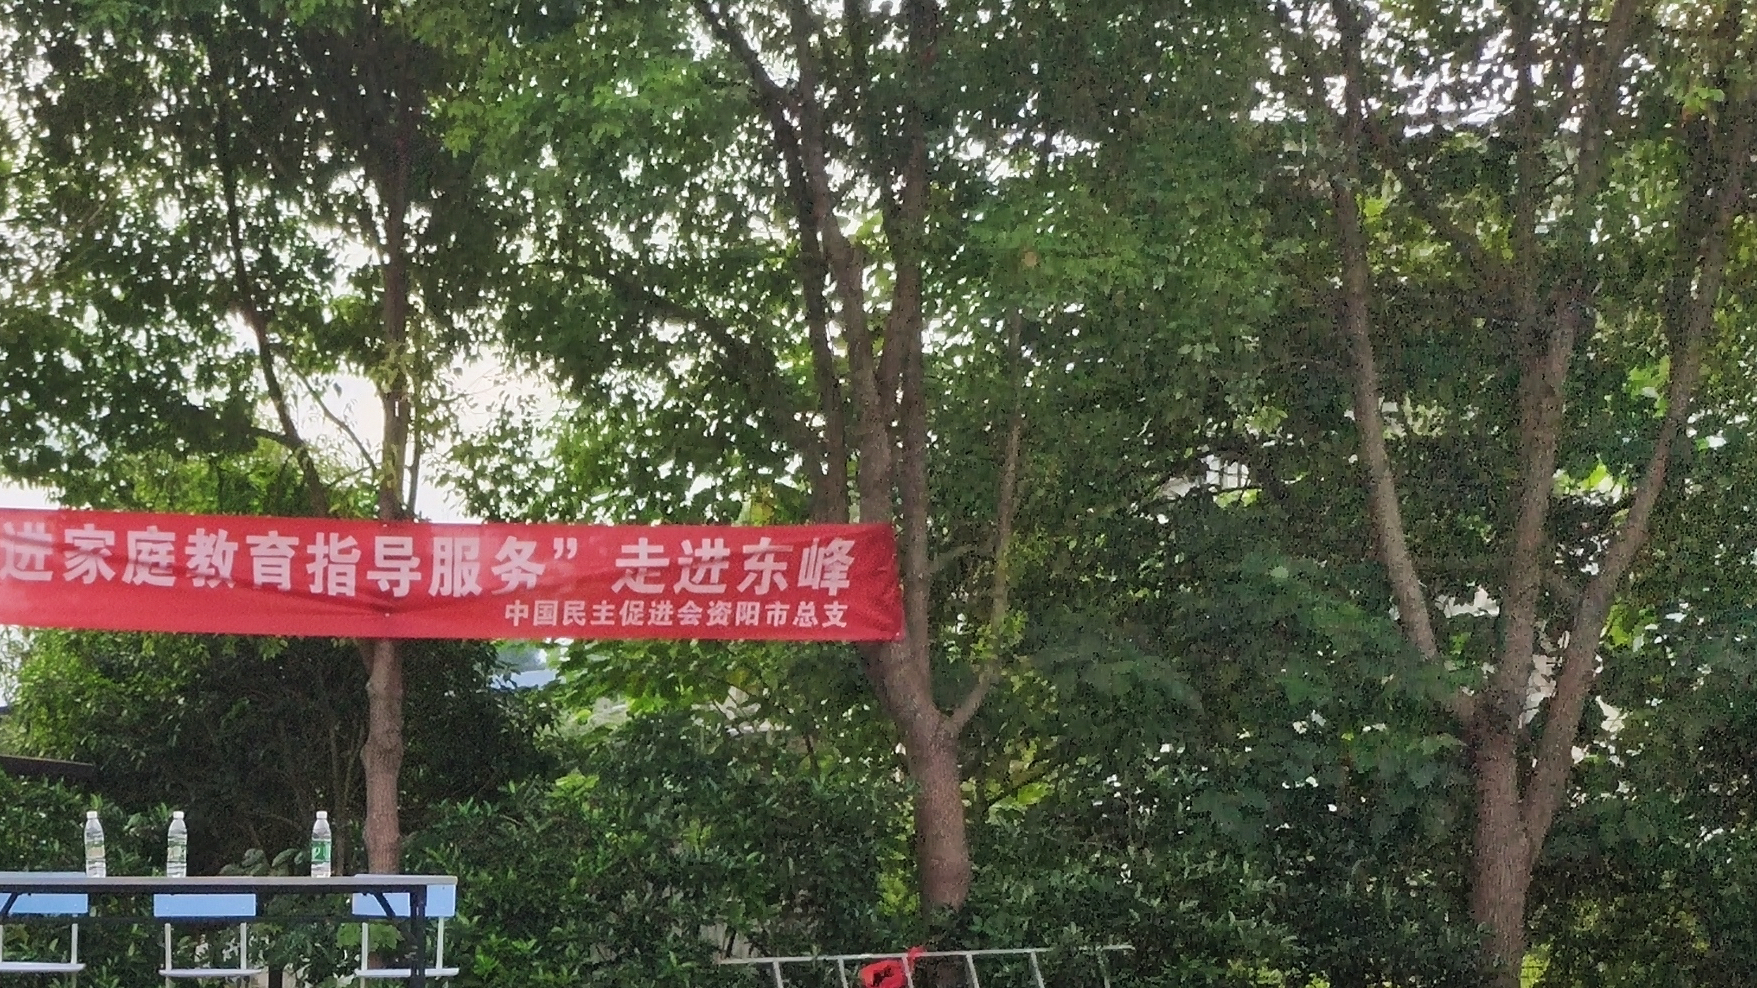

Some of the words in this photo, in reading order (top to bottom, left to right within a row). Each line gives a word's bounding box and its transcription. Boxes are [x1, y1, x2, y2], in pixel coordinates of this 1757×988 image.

[505, 599, 849, 629] 中国民主促进会资阳市总支
